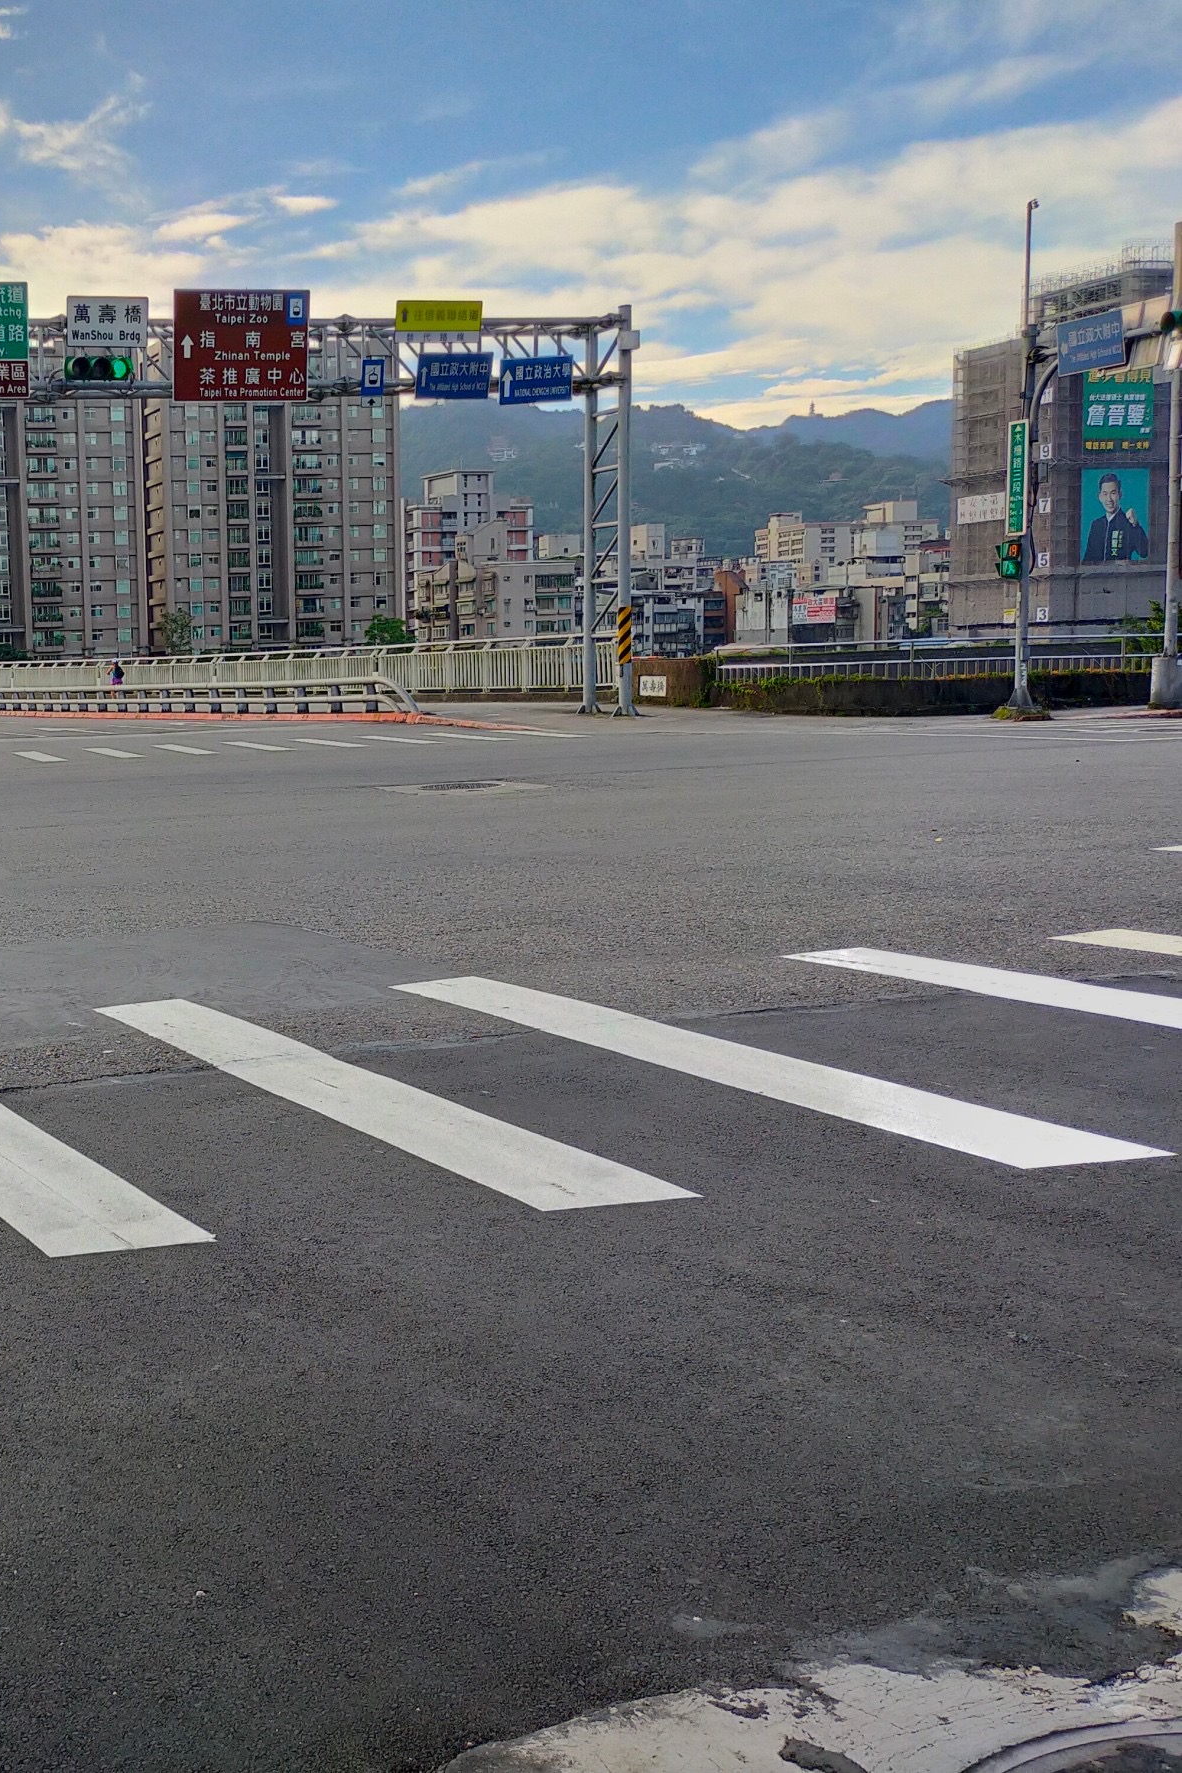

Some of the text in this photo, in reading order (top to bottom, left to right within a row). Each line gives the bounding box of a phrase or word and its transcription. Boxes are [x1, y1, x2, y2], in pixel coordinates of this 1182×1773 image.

[199, 293, 284, 311] 臺北市立動物園
[73, 304, 142, 324] 萬壽橋
[215, 314, 268, 325] Taipei Zoo
[71, 329, 143, 343] WanShou Brdg.
[199, 331, 306, 349] 指南宮
[214, 351, 291, 362] Zhinan Temple
[199, 367, 305, 385] 茶推廣中心
[515, 363, 570, 380] 國立政治大學
[7, 384, 27, 394] Area
[199, 387, 305, 399] Taipei Tea Promotion Center
[1041, 446, 1050, 458] 9
[1041, 500, 1049, 512] 7
[1040, 554, 1048, 566] 5
[1038, 608, 1047, 621] 3
